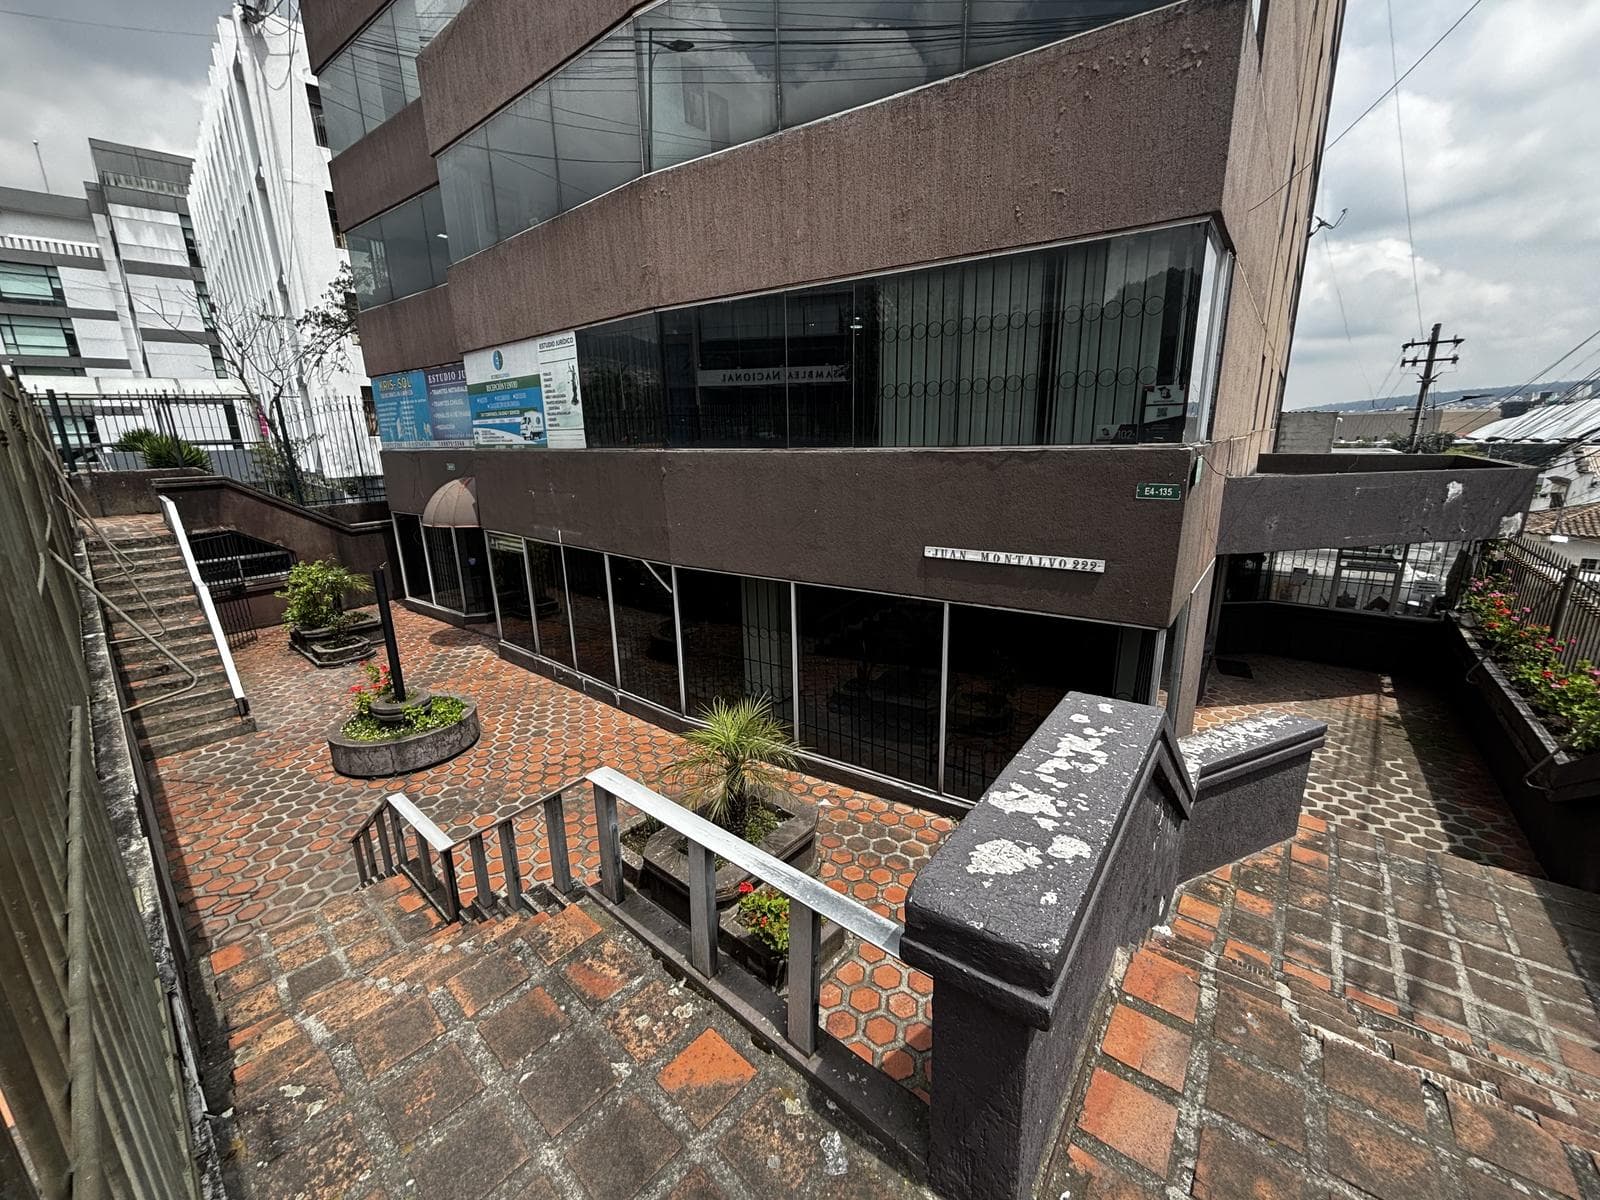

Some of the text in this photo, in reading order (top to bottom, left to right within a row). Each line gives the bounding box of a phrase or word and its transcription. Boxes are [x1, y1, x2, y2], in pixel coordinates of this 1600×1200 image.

[428, 372, 456, 384] ESTUDIO
[1144, 487, 1173, 496] E4-135
[932, 548, 1097, 572] JUAN MONTALVO 222
